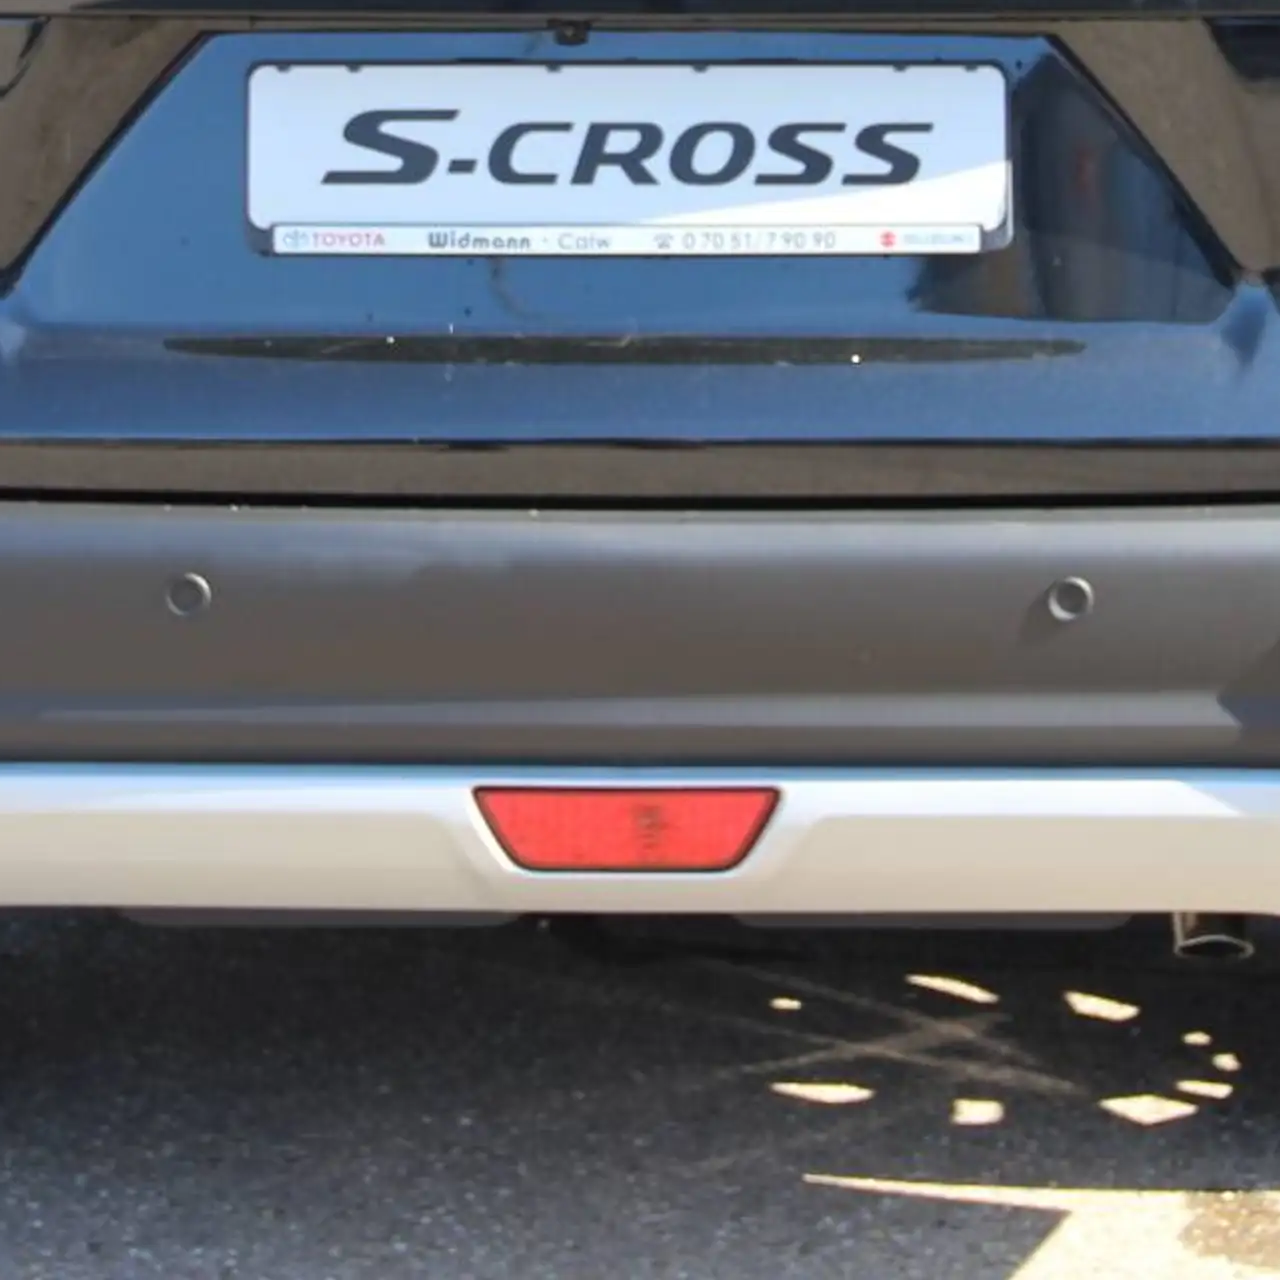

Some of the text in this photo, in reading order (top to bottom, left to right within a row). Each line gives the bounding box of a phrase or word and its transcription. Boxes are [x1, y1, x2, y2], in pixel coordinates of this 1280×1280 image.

[320, 108, 934, 187] S-CROSS
[312, 232, 386, 247] TOYOTA
[428, 231, 530, 250] Widmann
